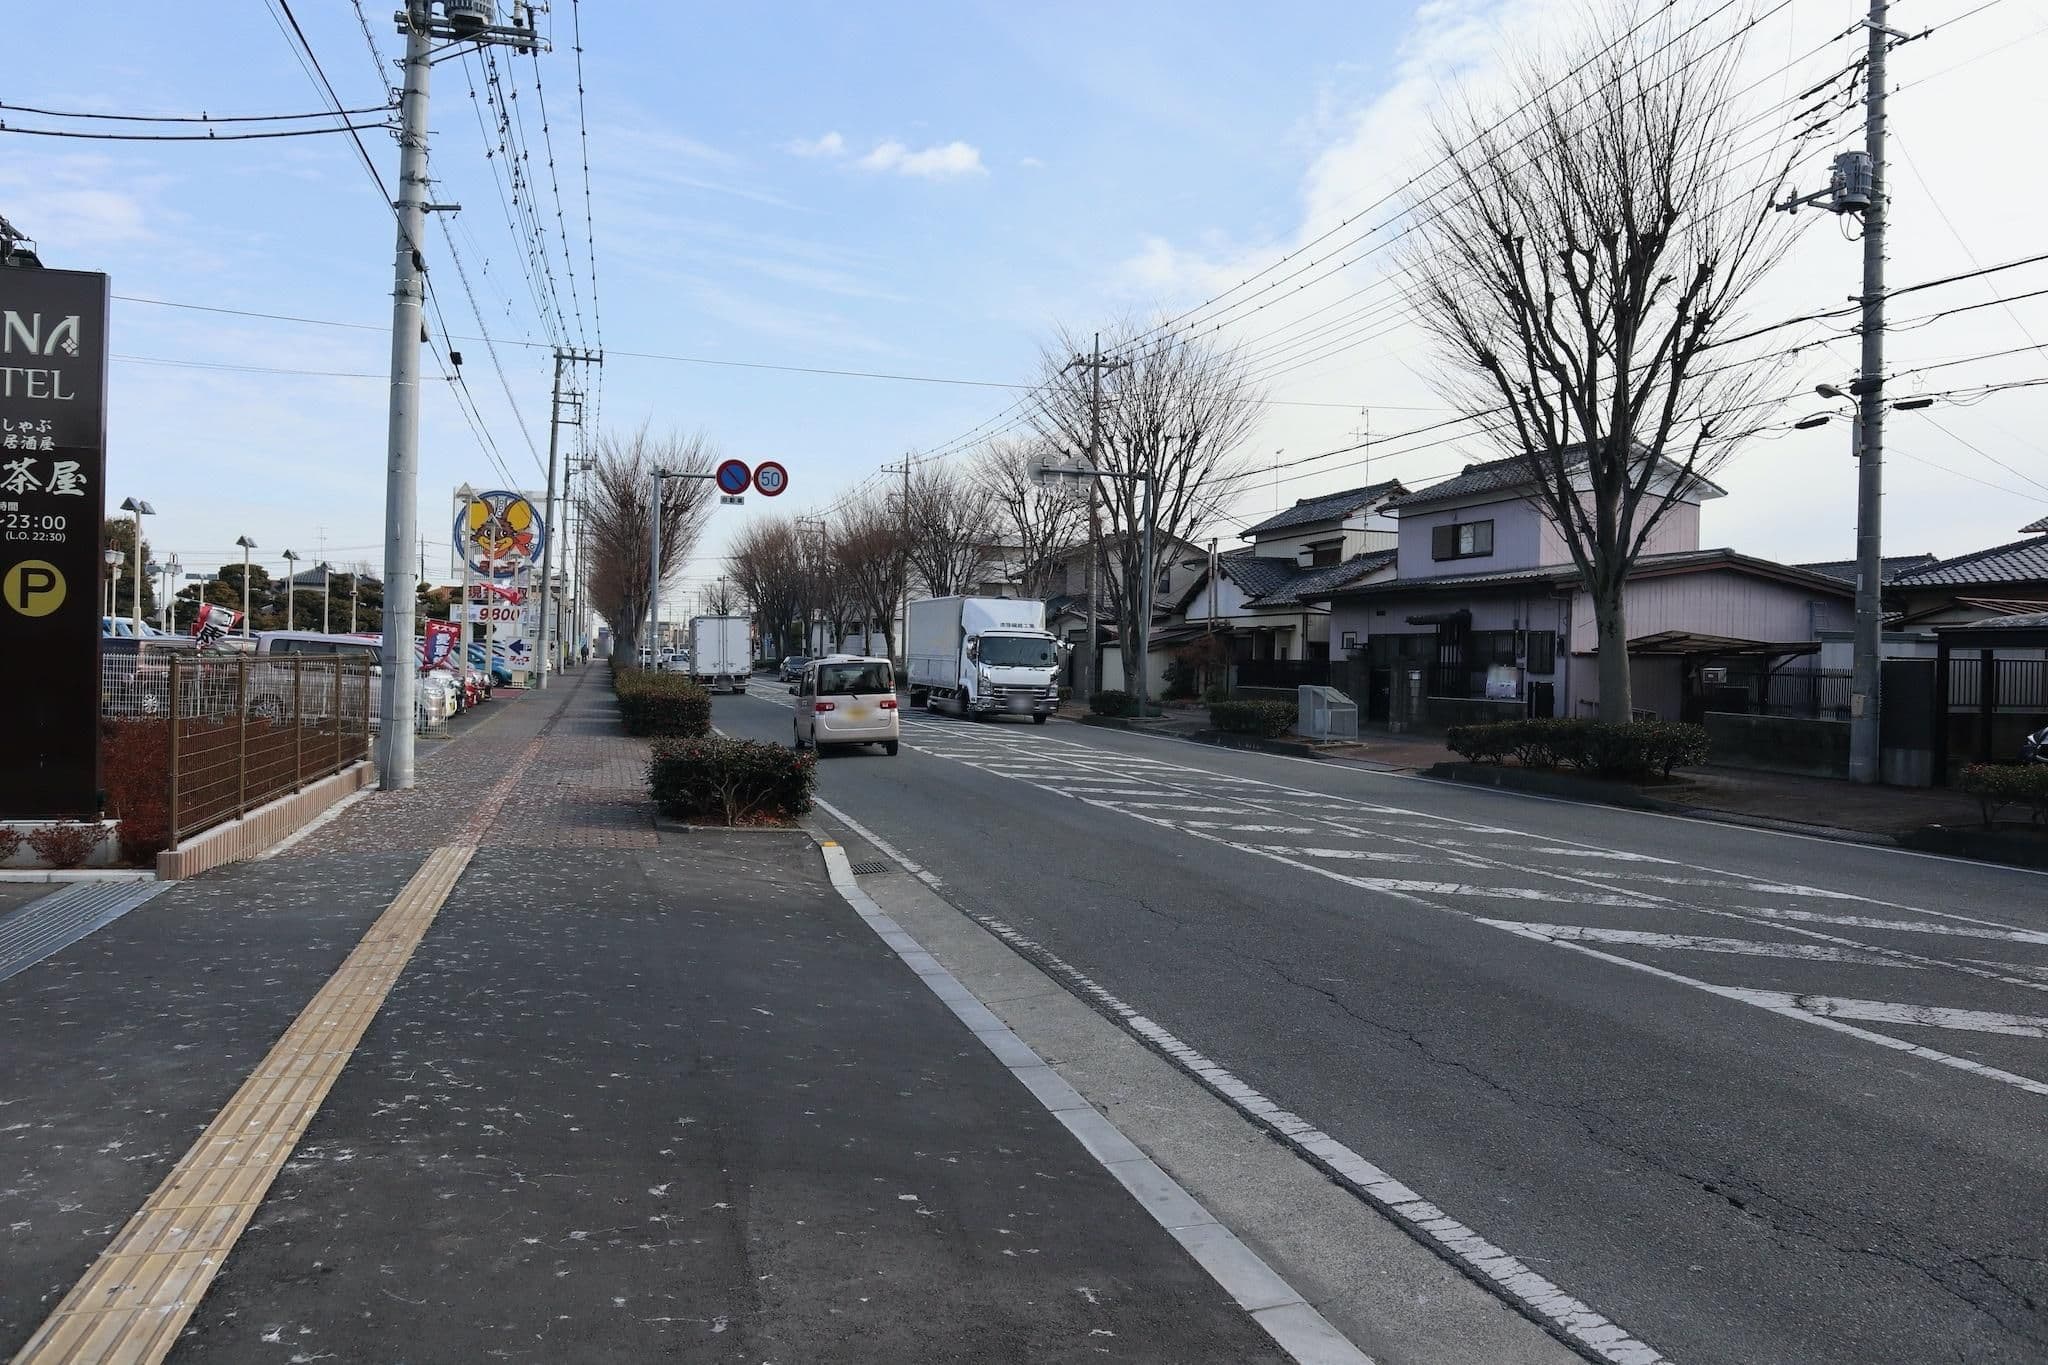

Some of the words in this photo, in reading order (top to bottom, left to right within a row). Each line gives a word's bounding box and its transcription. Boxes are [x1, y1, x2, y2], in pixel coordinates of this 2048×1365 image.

[3, 310, 80, 357] NA
[0, 366, 75, 400] TEL
[3, 418, 52, 433] しゃぶ
[3, 434, 55, 451] 居酒屋
[0, 457, 87, 496] 茶屋
[761, 471, 780, 487] 50
[6, 531, 30, 541] (L.O.
[32, 531, 66, 543] 22:30)
[20, 567, 56, 609] P
